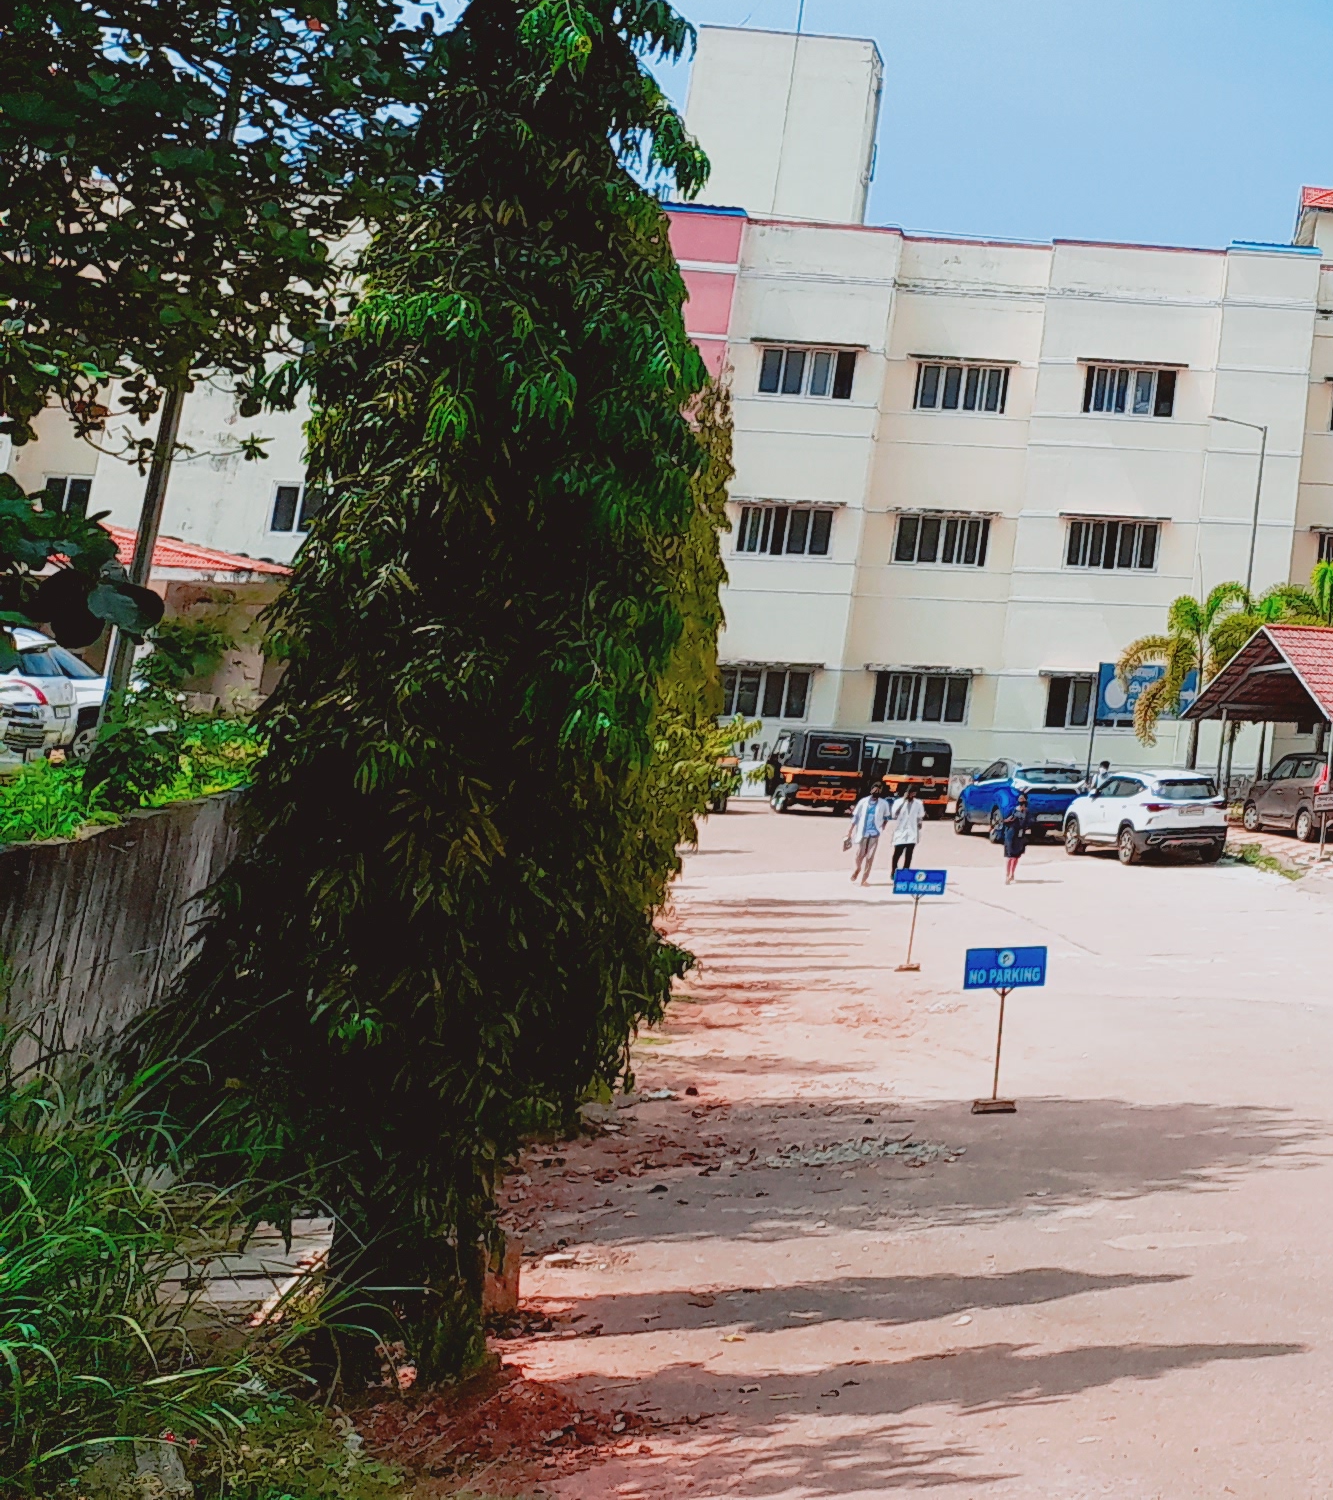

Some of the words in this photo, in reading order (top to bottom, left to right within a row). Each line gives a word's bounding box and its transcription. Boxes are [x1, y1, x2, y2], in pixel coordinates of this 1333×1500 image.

[895, 882, 907, 891] NO
[908, 882, 942, 892] PARKING
[967, 969, 987, 984] NO
[988, 967, 1041, 984] PARKING
